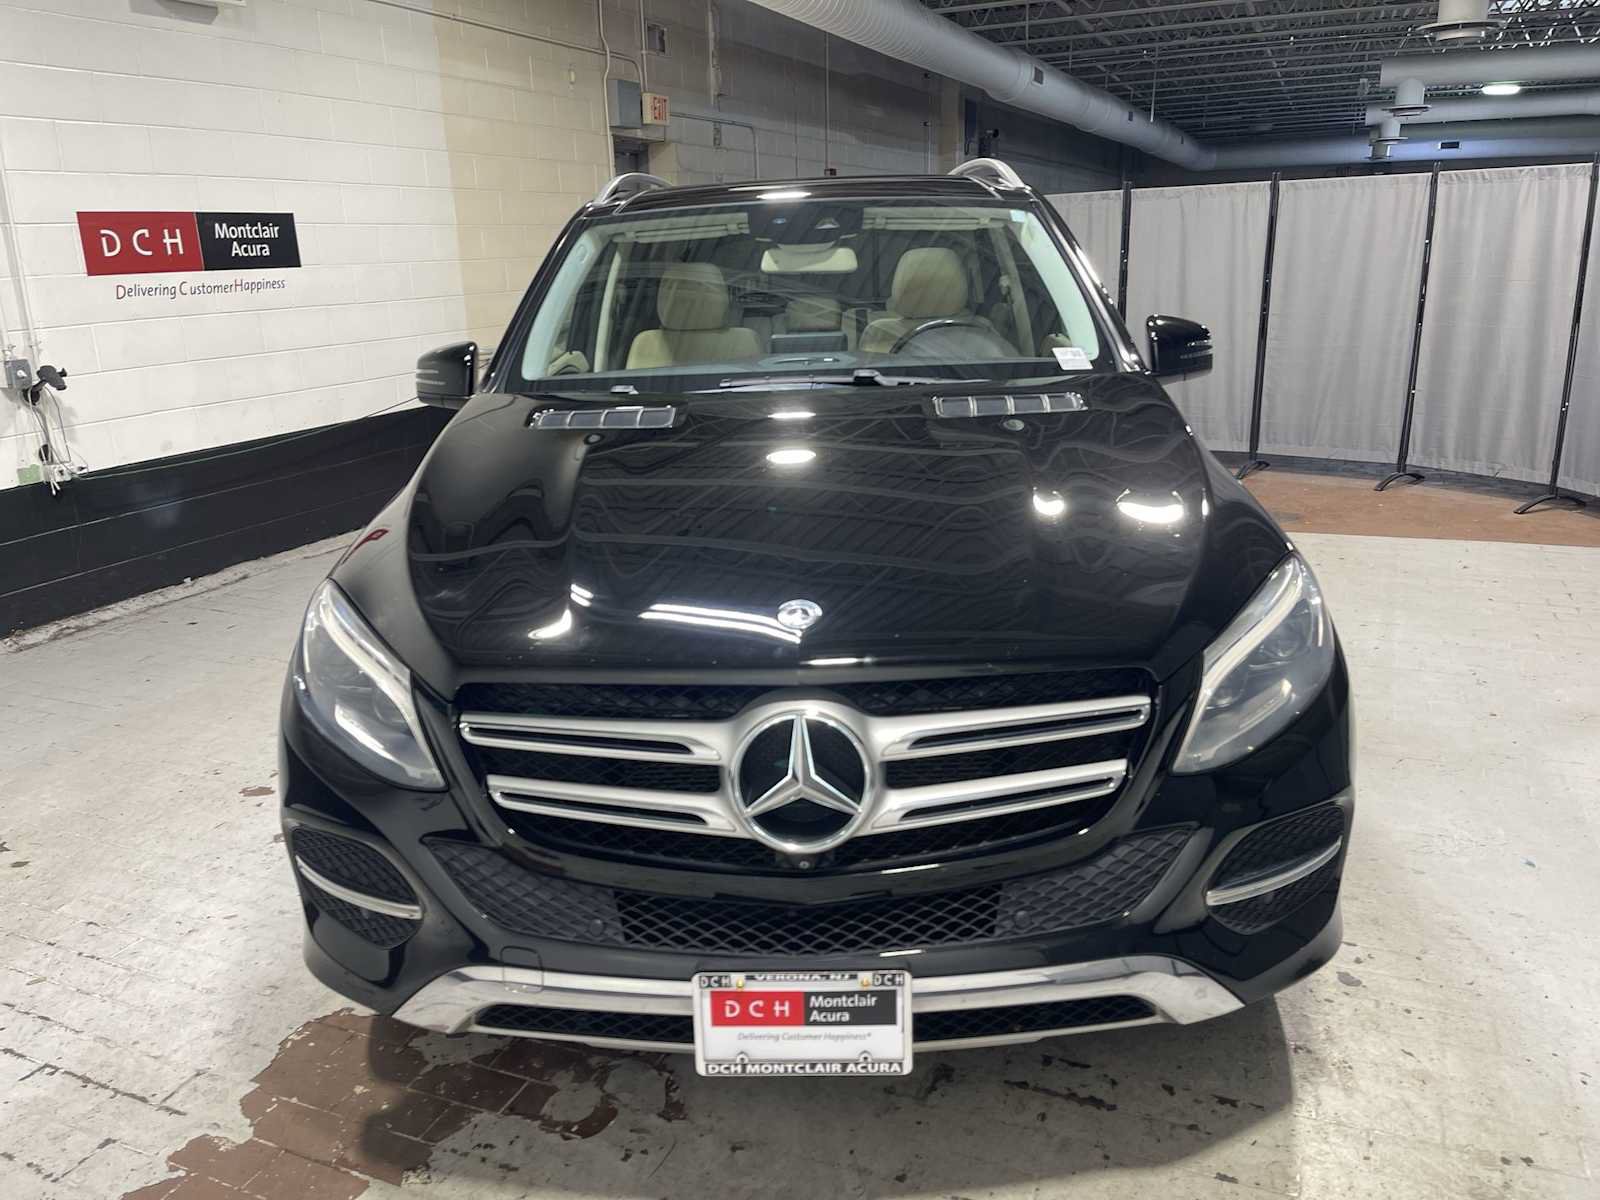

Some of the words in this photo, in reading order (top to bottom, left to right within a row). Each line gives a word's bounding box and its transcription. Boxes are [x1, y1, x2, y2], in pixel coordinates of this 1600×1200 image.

[214, 223, 280, 239] Montclair
[231, 241, 270, 257] Acura
[116, 283, 177, 300] Delivering
[874, 973, 904, 986] DCH
[809, 995, 878, 1009] Montclair
[809, 1010, 850, 1022] Acura
[737, 1032, 780, 1042] Delivering
[781, 1032, 822, 1041] Customer
[708, 1063, 742, 1075] DCH
[746, 1063, 843, 1074] MONTCLAIR
[845, 1062, 901, 1074] ACURA
